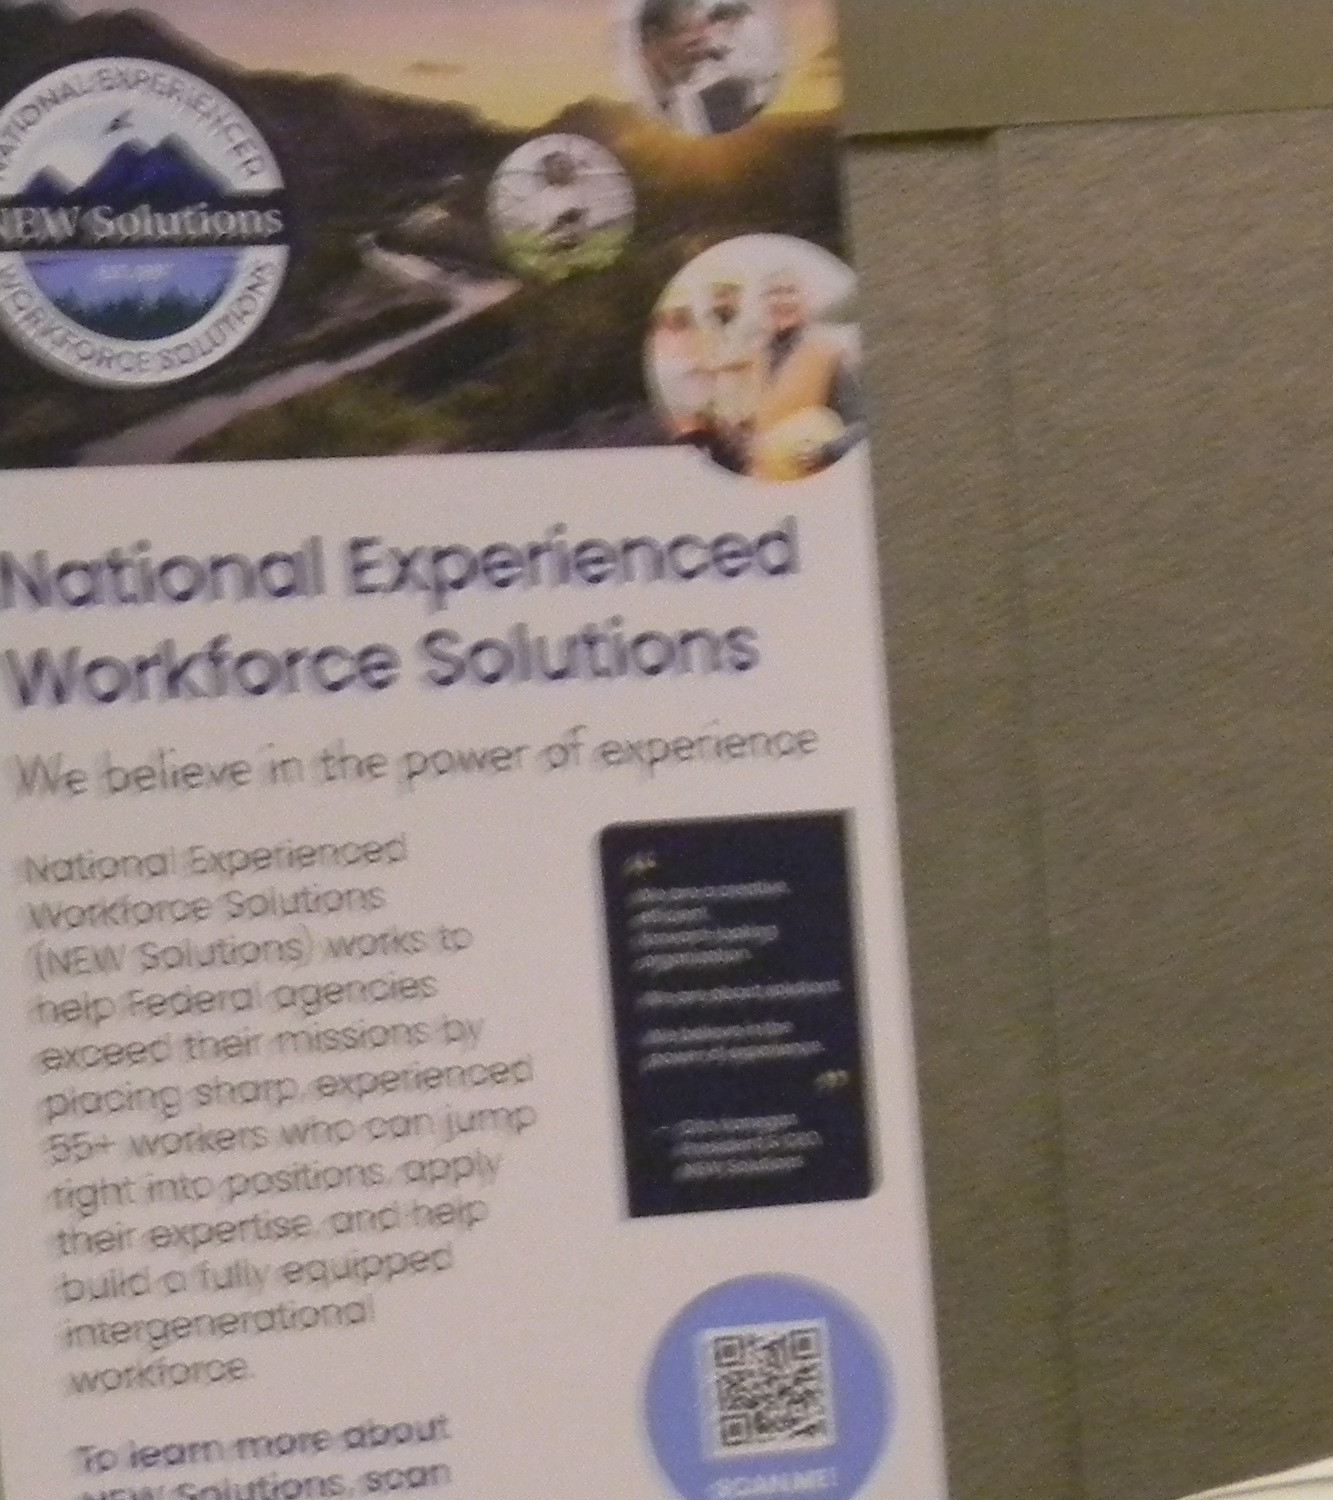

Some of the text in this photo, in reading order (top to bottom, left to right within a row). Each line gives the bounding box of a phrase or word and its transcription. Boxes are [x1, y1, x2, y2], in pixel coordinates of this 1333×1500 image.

[0, 77, 93, 178] ATIONAL
[88, 201, 285, 239] Solutions
[160, 259, 280, 371] SOLUTIONS
[0, 515, 802, 610] National Experienced
[4, 615, 761, 706] Workforce Solutions
[15, 720, 819, 796] We believe in the power of experience
[23, 833, 408, 884] National Experienced
[27, 883, 387, 931] Workforce Solutions
[33, 923, 473, 980] (NEW Solutions) works to
[34, 970, 439, 1029] help Federal agencies
[41, 1013, 483, 1071] exceed their missions by
[45, 1081, 180, 1123] placing
[315, 1054, 534, 1100] experienced
[49, 1104, 537, 1163] 55+ workers who can jump
[54, 1177, 136, 1217] right
[148, 1170, 215, 1202] into
[404, 1149, 502, 1189] apply
[59, 1224, 136, 1257] their
[330, 1203, 399, 1234] and
[410, 1198, 490, 1229] help
[63, 1243, 455, 1304] build a fully equipped
[66, 1297, 375, 1349] intergenerational
[77, 1415, 451, 1474] To learn more about
[366, 1462, 451, 1493] scan
